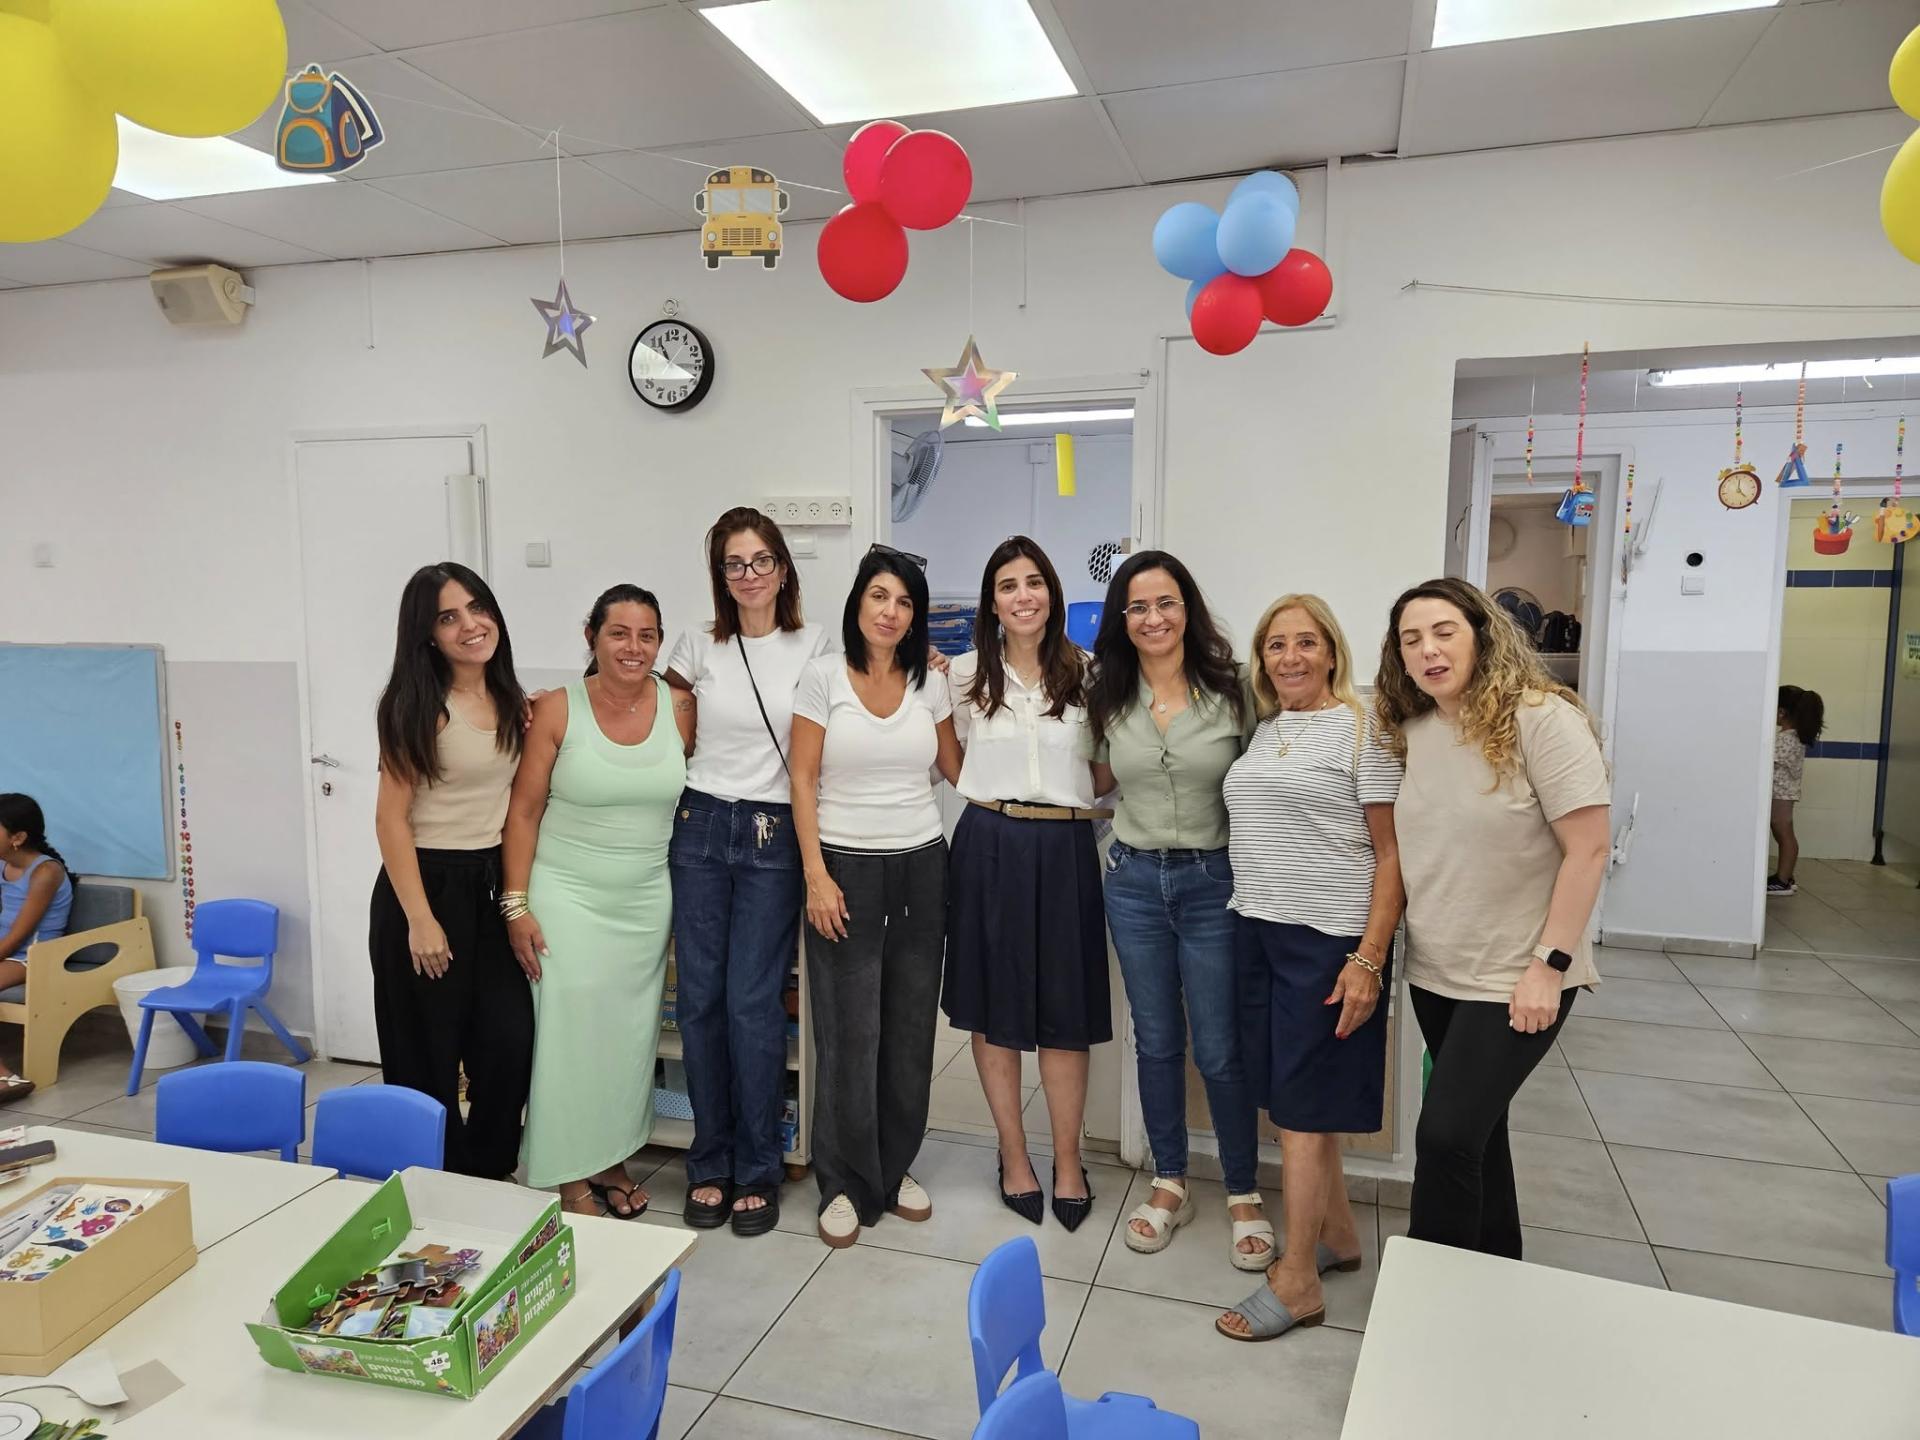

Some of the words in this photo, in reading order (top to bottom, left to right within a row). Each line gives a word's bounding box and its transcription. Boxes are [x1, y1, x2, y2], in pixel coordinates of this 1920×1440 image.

[650, 335, 663, 348] 11
[664, 329, 680, 342] 12
[689, 345, 699, 358] 2
[656, 386, 665, 400] 7
[667, 390, 677, 403] 6
[679, 384, 689, 398] 5
[180, 832, 191, 842] 10
[181, 866, 193, 876] 40
[430, 1357, 443, 1365] 48
